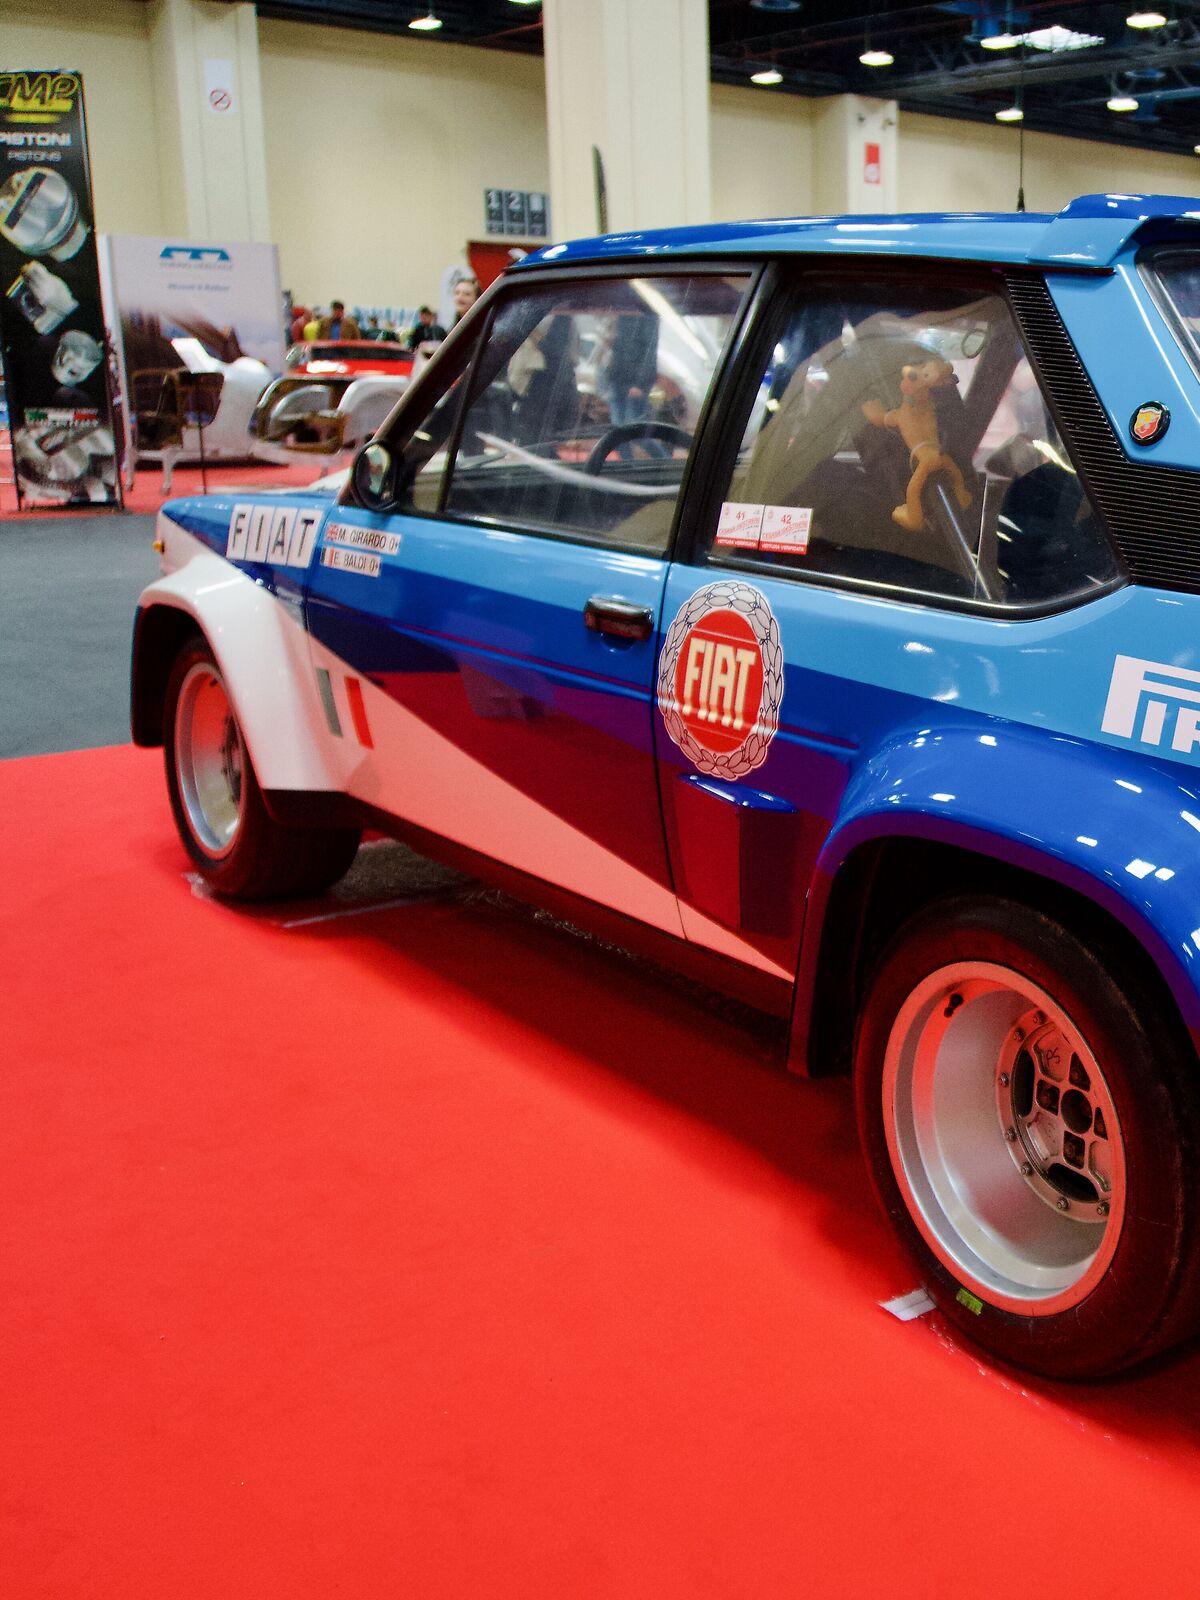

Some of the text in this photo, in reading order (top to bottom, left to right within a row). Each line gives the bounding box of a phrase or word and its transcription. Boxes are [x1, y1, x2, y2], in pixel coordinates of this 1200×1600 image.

[488, 190, 521, 211] 1 2
[781, 514, 792, 525] 42
[232, 512, 315, 558] FIAT
[350, 530, 387, 550] GIRARDO
[344, 554, 367, 570] BALDI
[682, 637, 757, 728] FIAT
